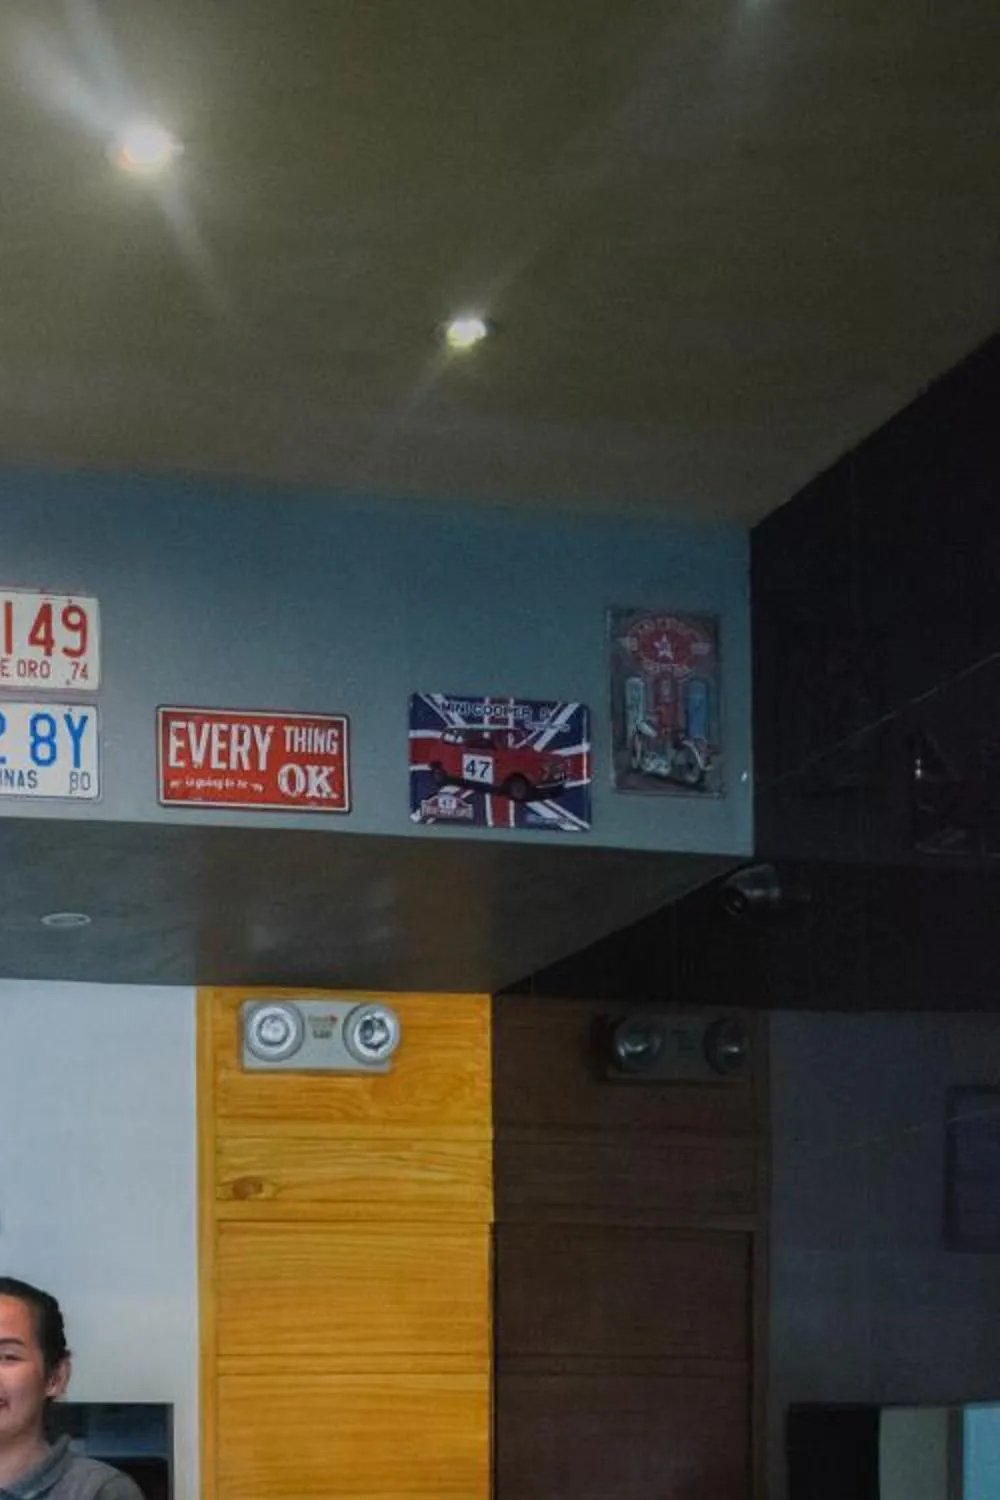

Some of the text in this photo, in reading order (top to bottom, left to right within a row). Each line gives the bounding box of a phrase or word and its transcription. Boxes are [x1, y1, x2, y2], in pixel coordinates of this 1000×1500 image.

[4, 600, 89, 658] 149
[16, 659, 51, 679] ORO
[70, 661, 89, 681] 74
[29, 712, 89, 769] 8Y
[168, 720, 340, 771] EVERY THING
[277, 762, 340, 800] OK
[465, 759, 491, 779] 47
